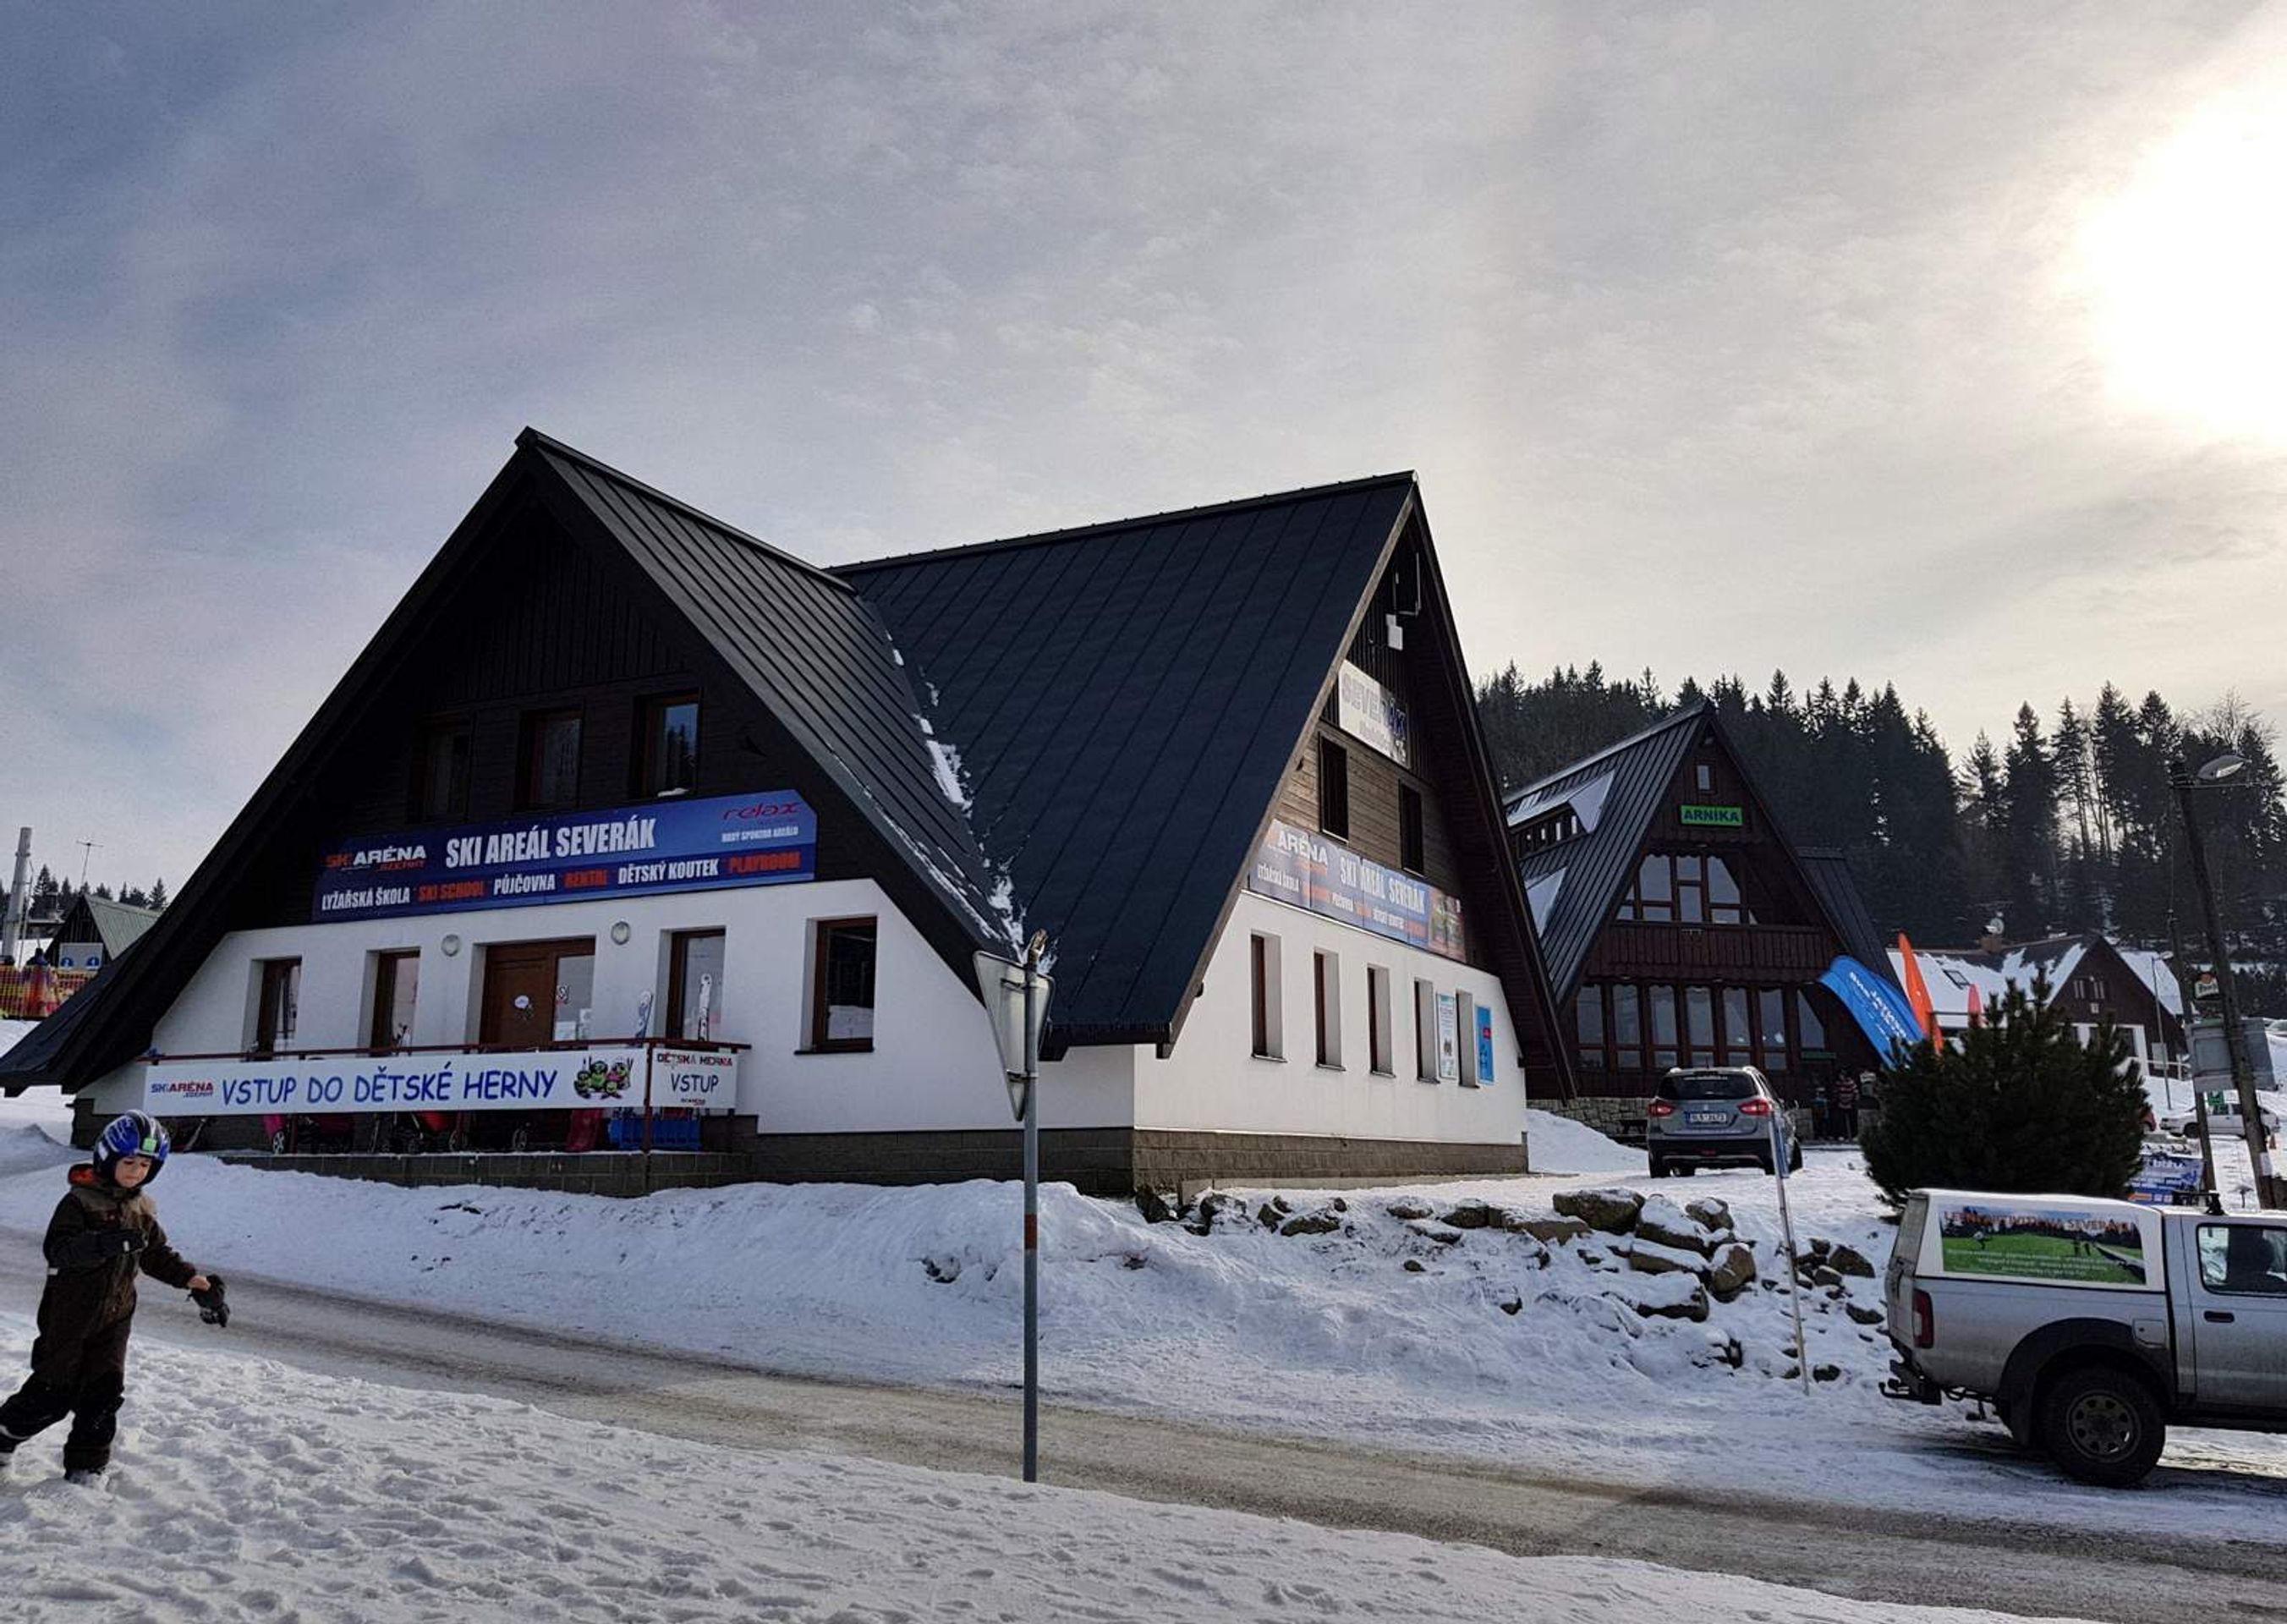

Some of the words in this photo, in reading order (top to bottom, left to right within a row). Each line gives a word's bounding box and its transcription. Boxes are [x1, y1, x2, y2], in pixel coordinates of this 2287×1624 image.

[721, 803, 800, 821] relax
[1683, 809, 1740, 822] ARNIKA
[353, 846, 427, 866] ARÉNA
[445, 836, 482, 869] SKI
[485, 825, 551, 864] AREÁL
[556, 815, 656, 858] SEVERÁK
[1277, 830, 1329, 867] ARÉNA
[321, 887, 373, 911] LYŽAŘSKÁ
[375, 886, 410, 906] ŠKOLA
[419, 884, 438, 903] SKI
[440, 881, 485, 899] SCHOOL
[493, 873, 556, 896] PŮJČOVNA
[617, 859, 666, 885] DĚTSKÝ
[667, 858, 720, 881] KOUTEK
[222, 1077, 297, 1106] VSTUP
[307, 1076, 343, 1103] DO
[354, 1061, 452, 1102] DĚTSKÉ
[463, 1070, 558, 1100] HERNY
[671, 1073, 719, 1093] VSTUP
